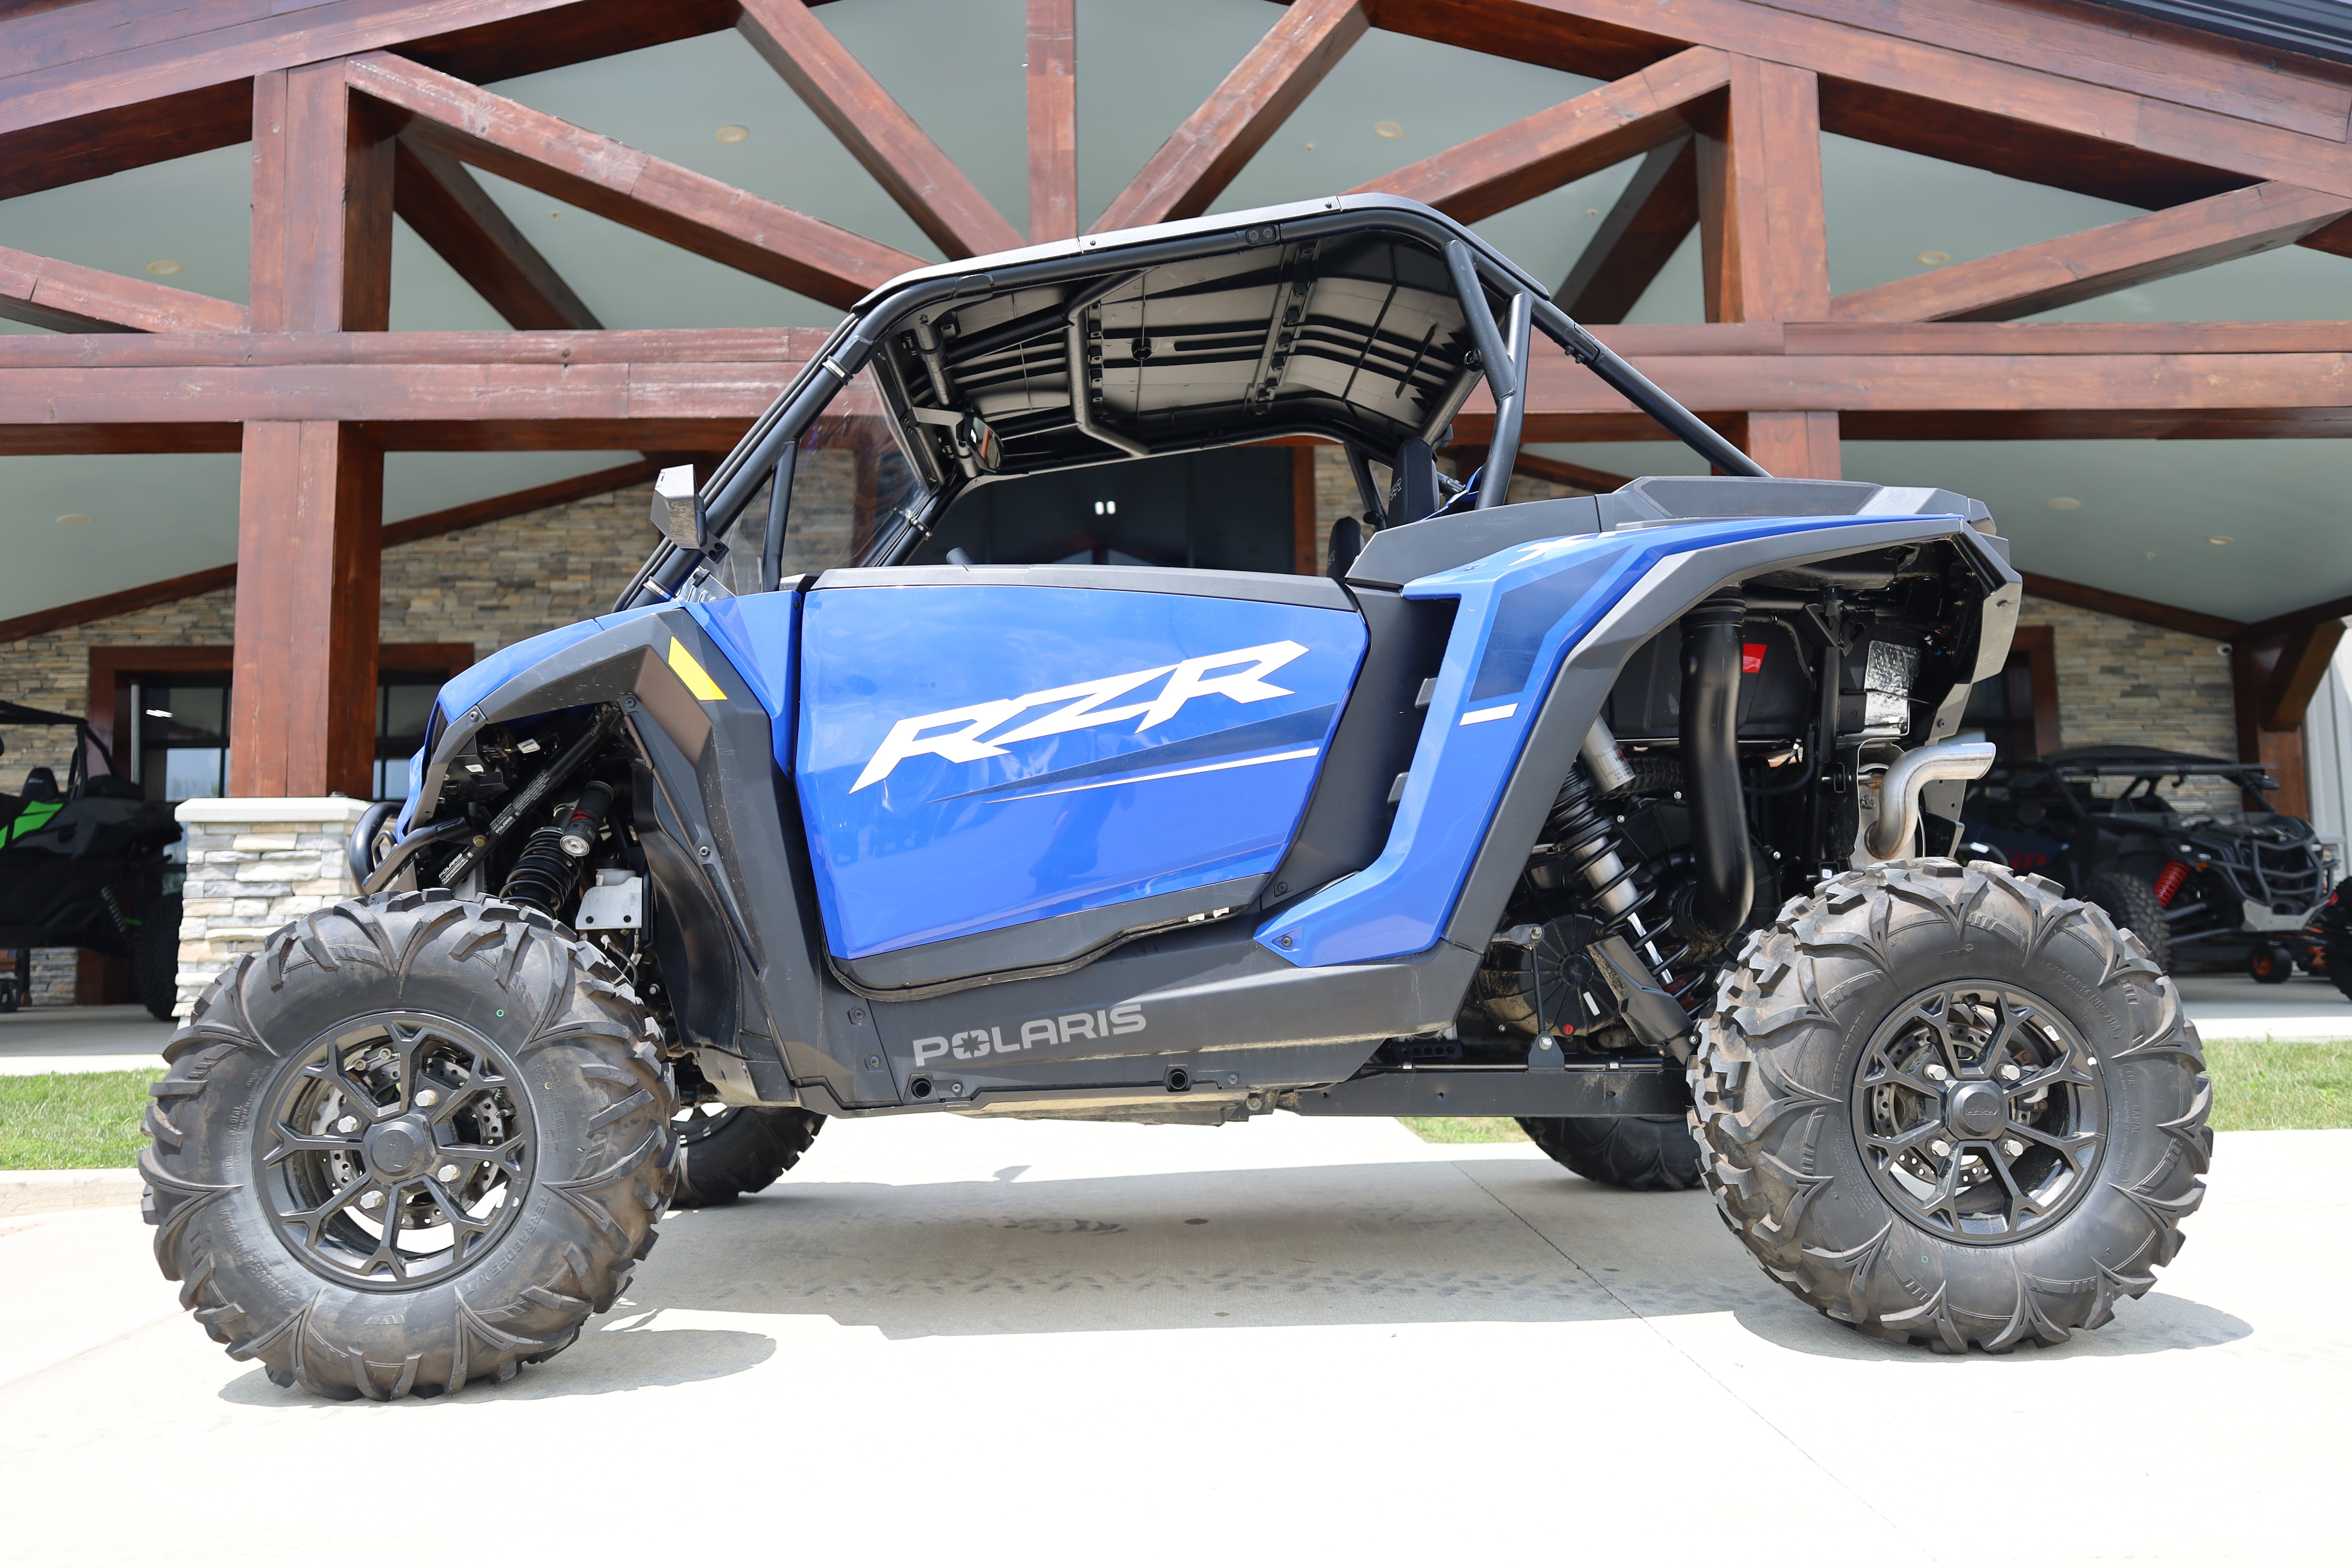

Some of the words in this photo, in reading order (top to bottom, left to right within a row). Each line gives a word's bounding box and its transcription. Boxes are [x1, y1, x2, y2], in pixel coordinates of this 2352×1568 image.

[848, 640, 1311, 795] RZR
[495, 816, 513, 834] POLARIS
[439, 853, 462, 879] POLARIS
[2089, 994, 2109, 1015] NHS
[2104, 1011, 2122, 1032] 71M
[912, 1004, 1147, 1067] POLARIS
[228, 1106, 243, 1136] RADIAL
[2130, 1105, 2141, 1135] RADIAL
[2123, 1152, 2135, 1171] NYLON
[229, 1234, 248, 1256] NHS
